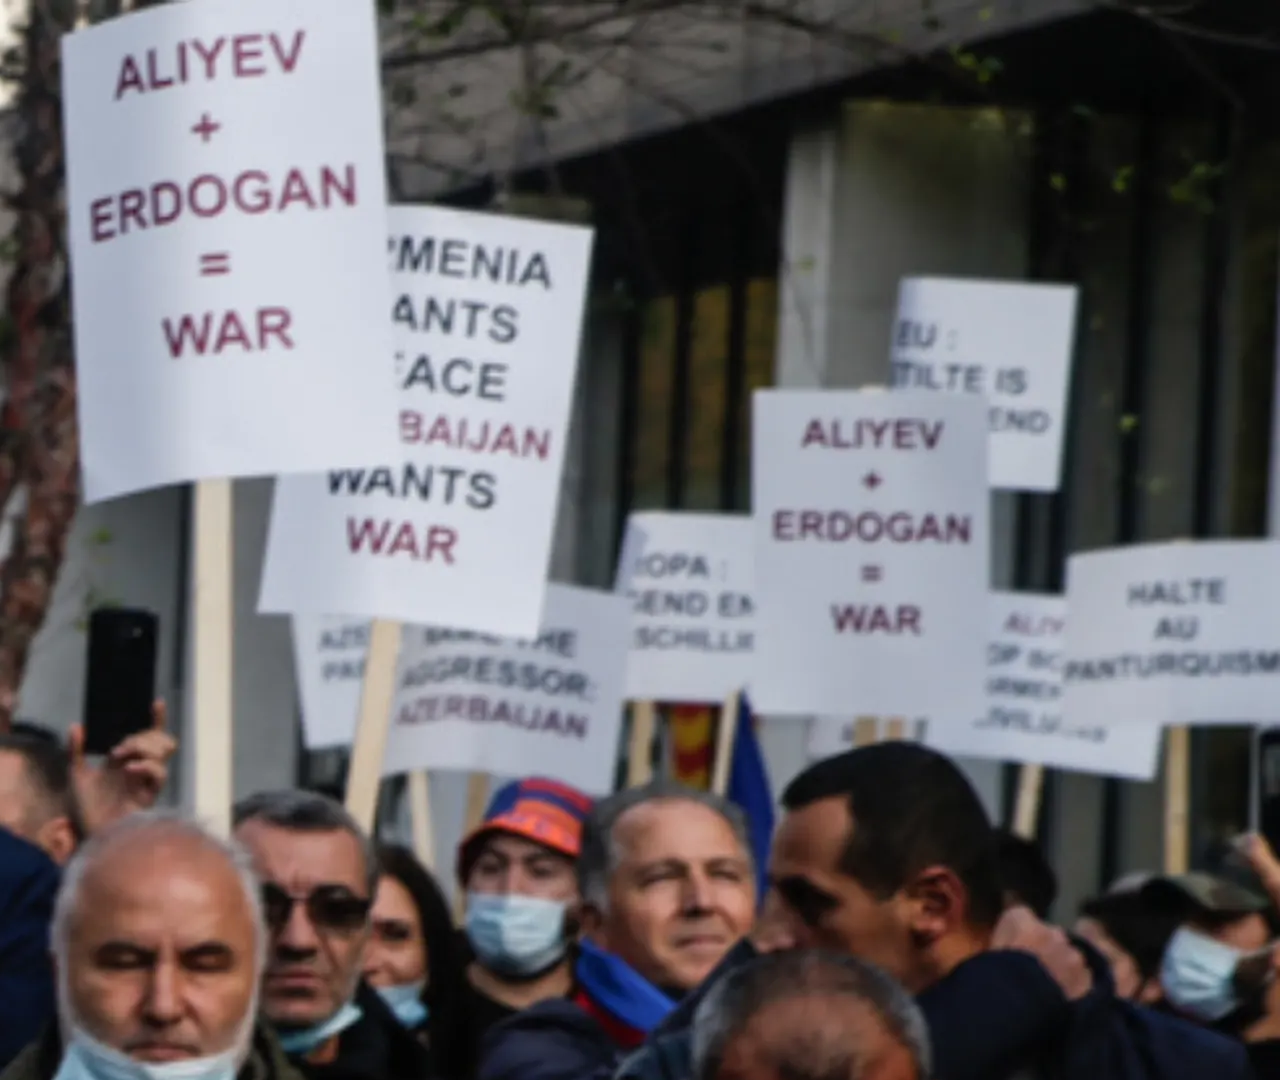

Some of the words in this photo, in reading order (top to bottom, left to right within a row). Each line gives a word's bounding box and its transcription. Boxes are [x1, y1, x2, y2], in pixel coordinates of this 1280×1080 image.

[114, 30, 306, 99] ALIYEV
[191, 113, 221, 142] +
[89, 164, 358, 243] ERDOGAN
[199, 252, 230, 276] =
[162, 307, 295, 358] WAR
[395, 353, 510, 402] ACE
[801, 418, 945, 450] ALIYEV
[346, 516, 458, 565] WAR
[772, 509, 972, 545] ERDOGAN
[829, 603, 921, 636] WAR
